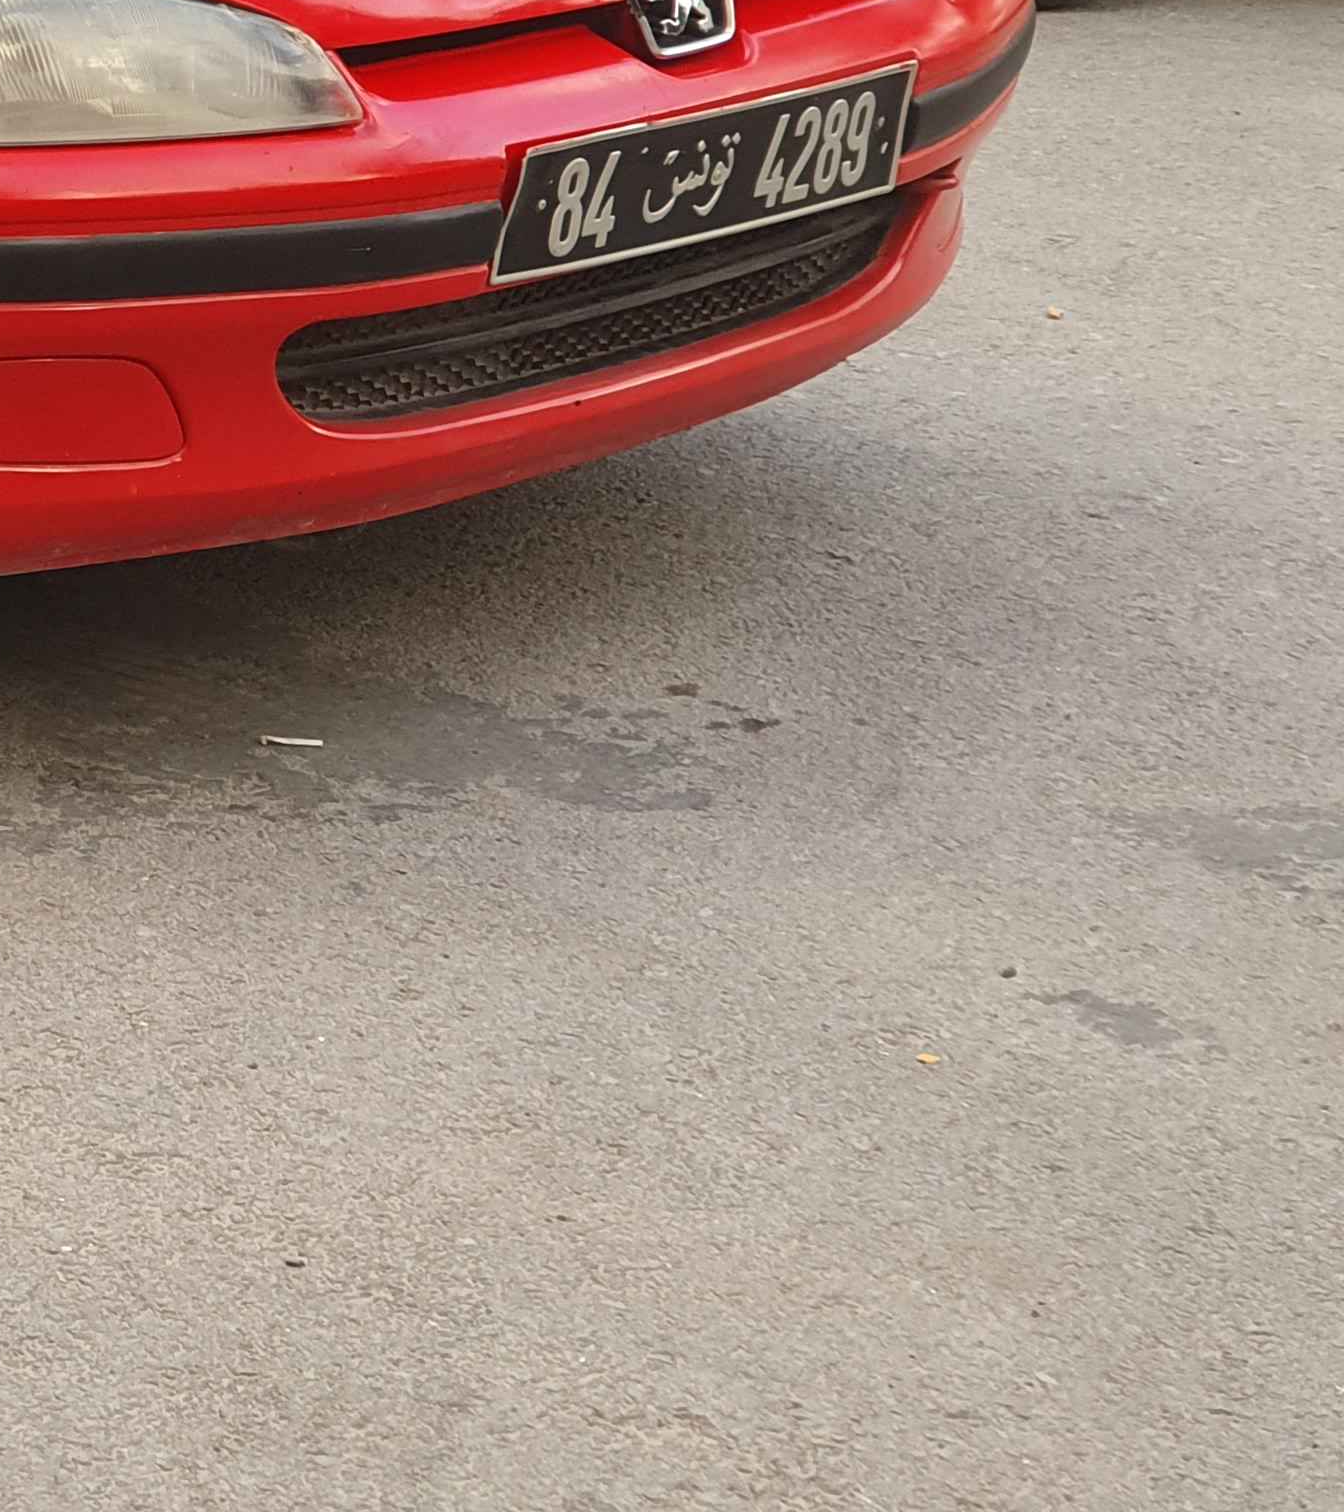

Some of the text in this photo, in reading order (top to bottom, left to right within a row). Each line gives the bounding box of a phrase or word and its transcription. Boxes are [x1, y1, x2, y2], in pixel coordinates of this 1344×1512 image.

[547, 92, 876, 257] 84 تونس 4289
